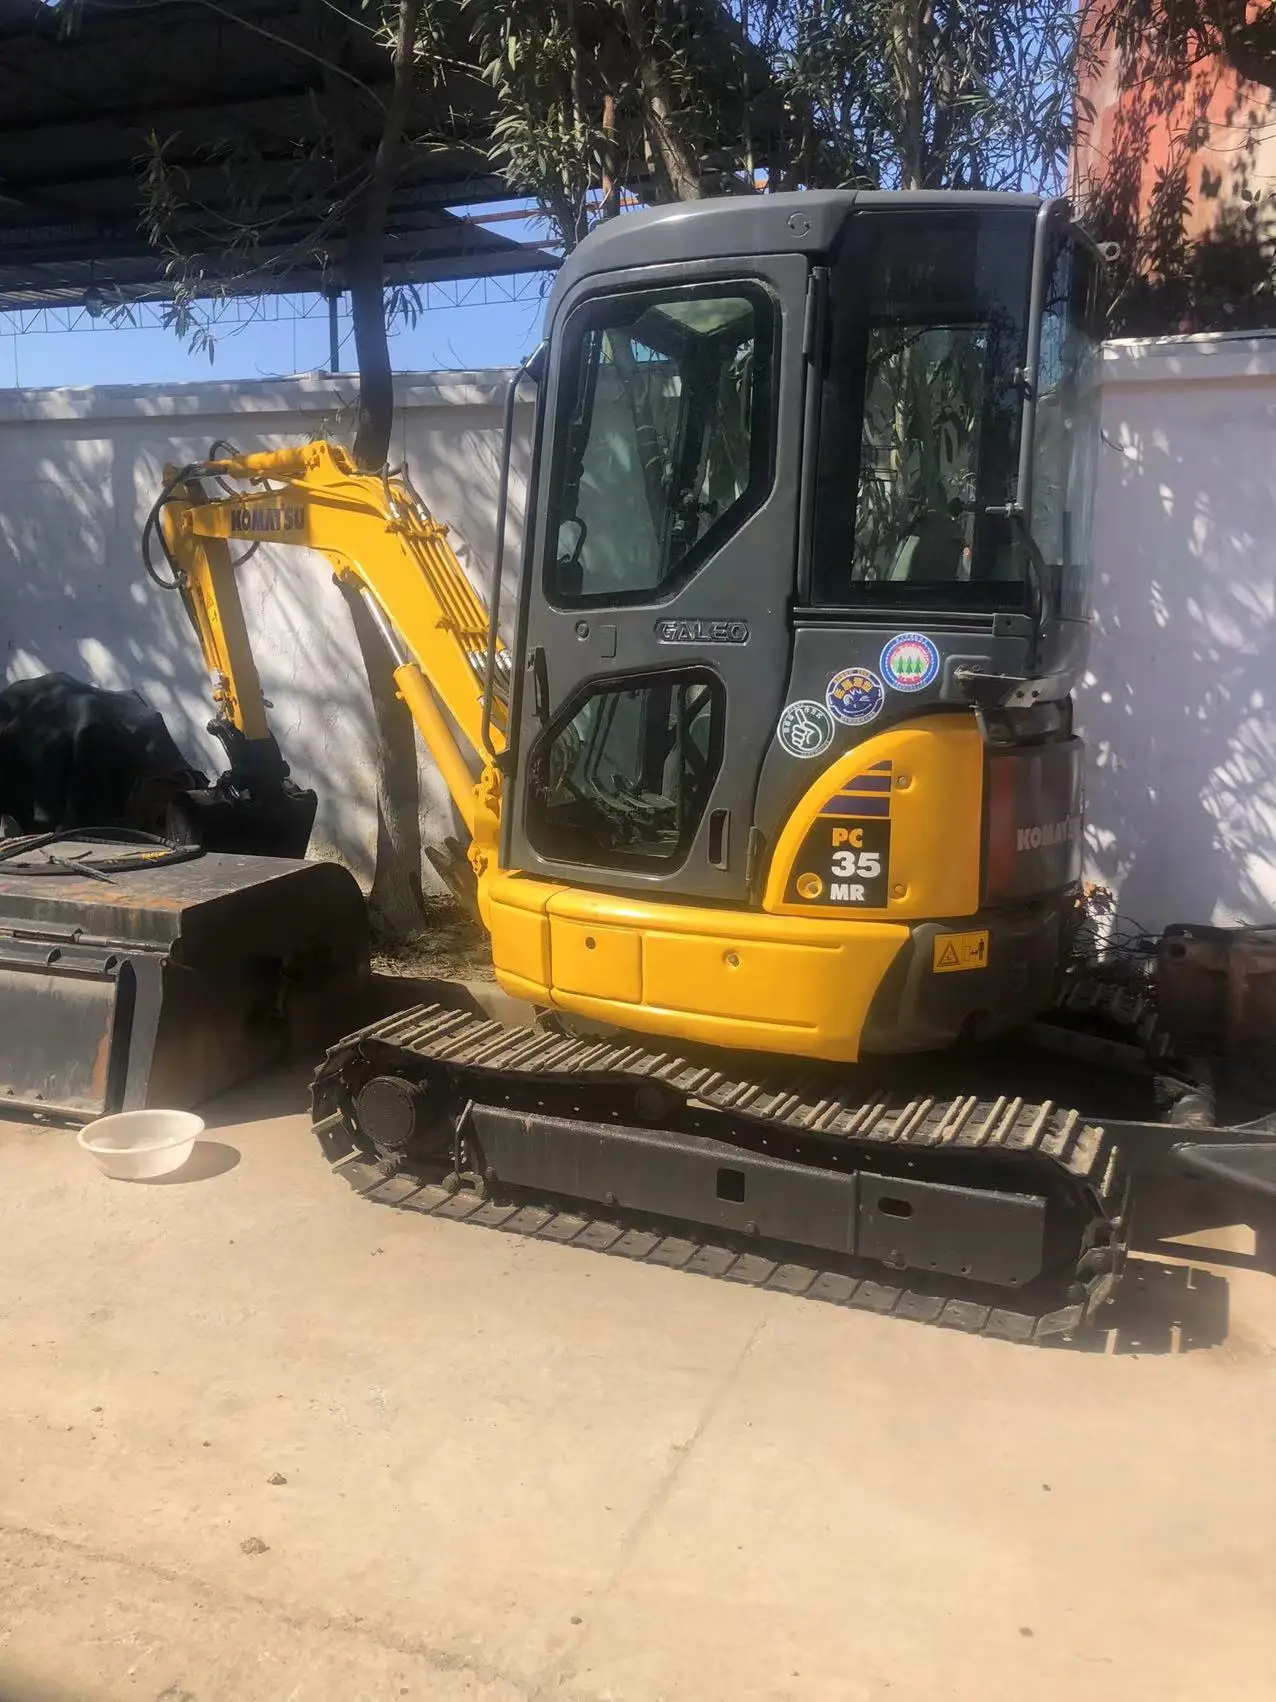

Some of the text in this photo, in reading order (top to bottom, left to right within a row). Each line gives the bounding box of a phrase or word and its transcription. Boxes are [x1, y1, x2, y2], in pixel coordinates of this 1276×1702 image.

[231, 503, 305, 531] KOMATSU
[660, 620, 748, 641] GALEO
[831, 827, 864, 847] PC
[830, 850, 881, 878] 35
[830, 883, 865, 901] MR
